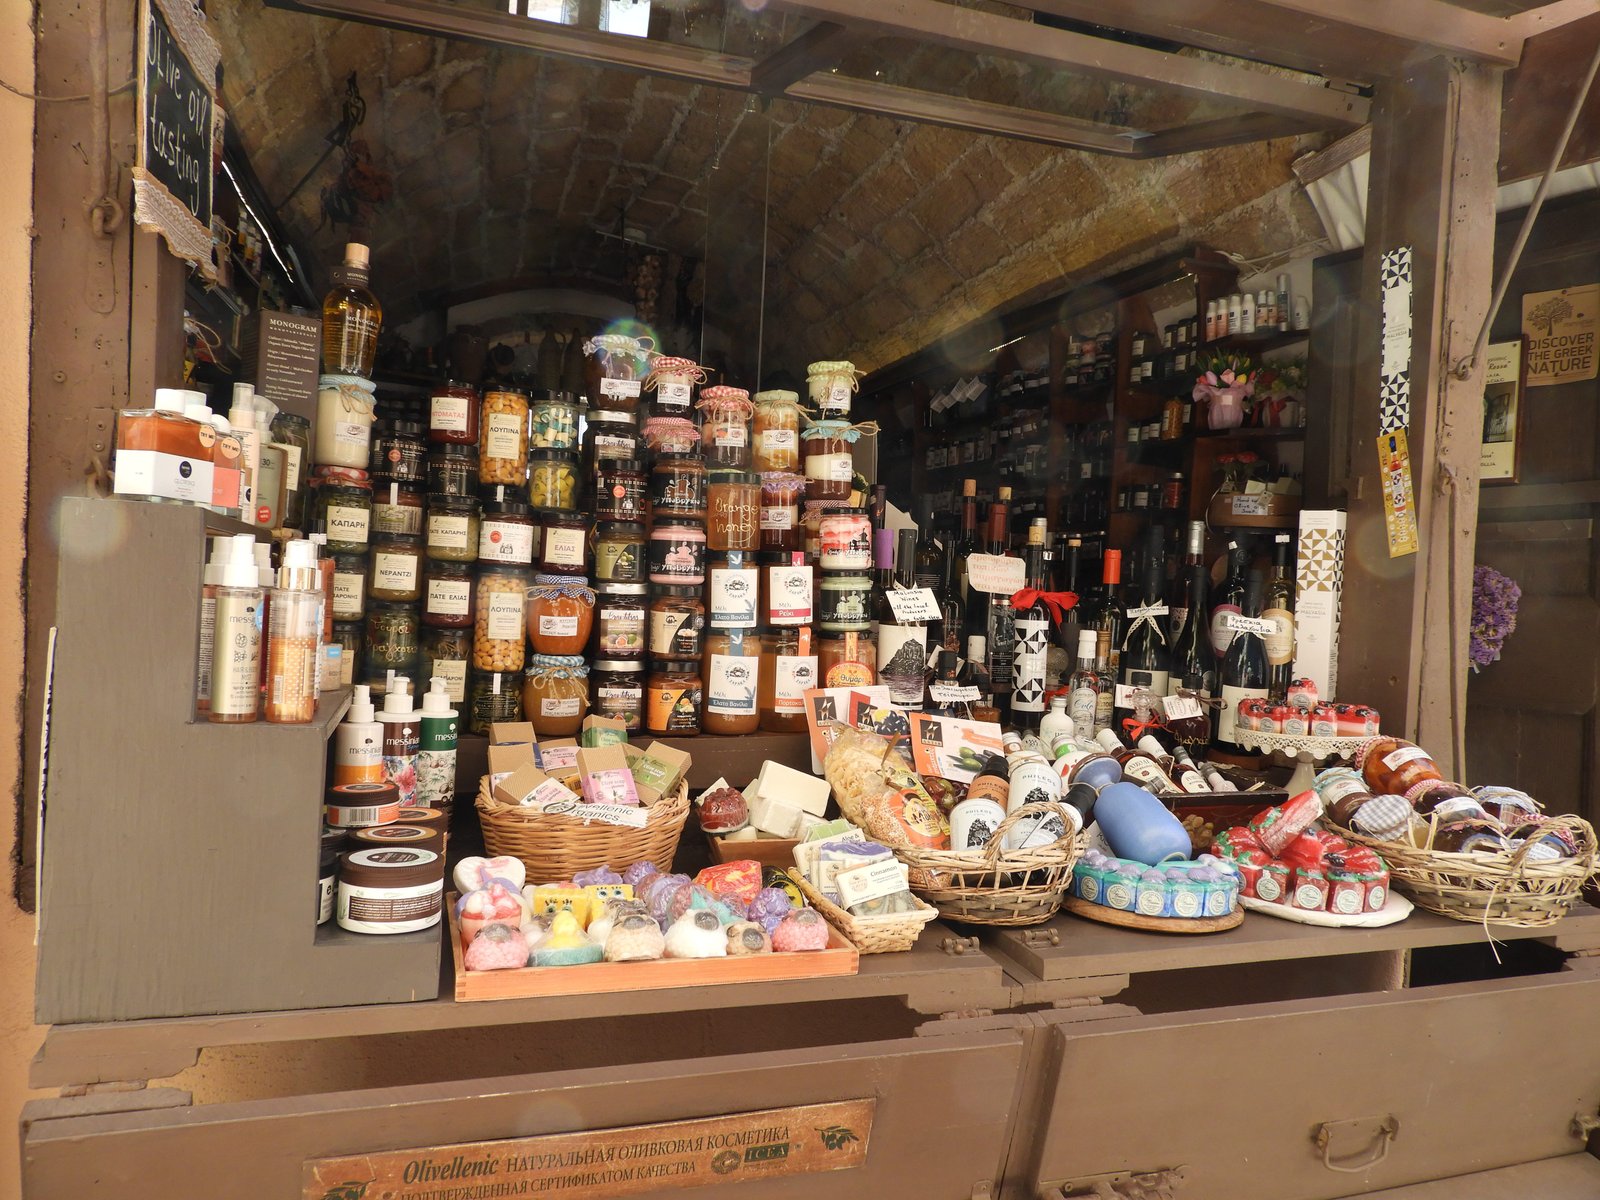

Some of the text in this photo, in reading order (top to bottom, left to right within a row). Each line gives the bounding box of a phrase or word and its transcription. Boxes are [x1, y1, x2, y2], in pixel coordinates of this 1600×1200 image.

[188, 88, 208, 149] oil
[150, 94, 200, 216] tasting
[269, 319, 317, 333] MONOGRAM
[1529, 332, 1594, 351] DISCOVER
[1528, 345, 1593, 361] THE GREEK
[1528, 355, 1592, 375] NATURE
[489, 426, 519, 435] ΛΟΥΠΙΝΑ
[715, 498, 759, 521] Orange
[331, 519, 365, 529] ΚΑΠΑΡΗ
[716, 519, 757, 542] honey
[554, 544, 576, 552] ΕΛΙΑΣ
[379, 569, 412, 577] ΝΕΡΑΝΤΖΙ
[490, 606, 521, 614] ΛΟΥΠΙΝΑ
[870, 864, 898, 877] Cinnamon
[506, 1126, 790, 1173] НАТУРАЛЬНАЯ ОЛИВКОВАЯ КОСМЕТИКА
[747, 1147, 788, 1161] ICEA
[403, 1153, 499, 1184] Olivellenic
[531, 1167, 635, 1190] СЕРТИФИКАТОМ
[637, 1160, 696, 1180] КАЧЕСТВА
